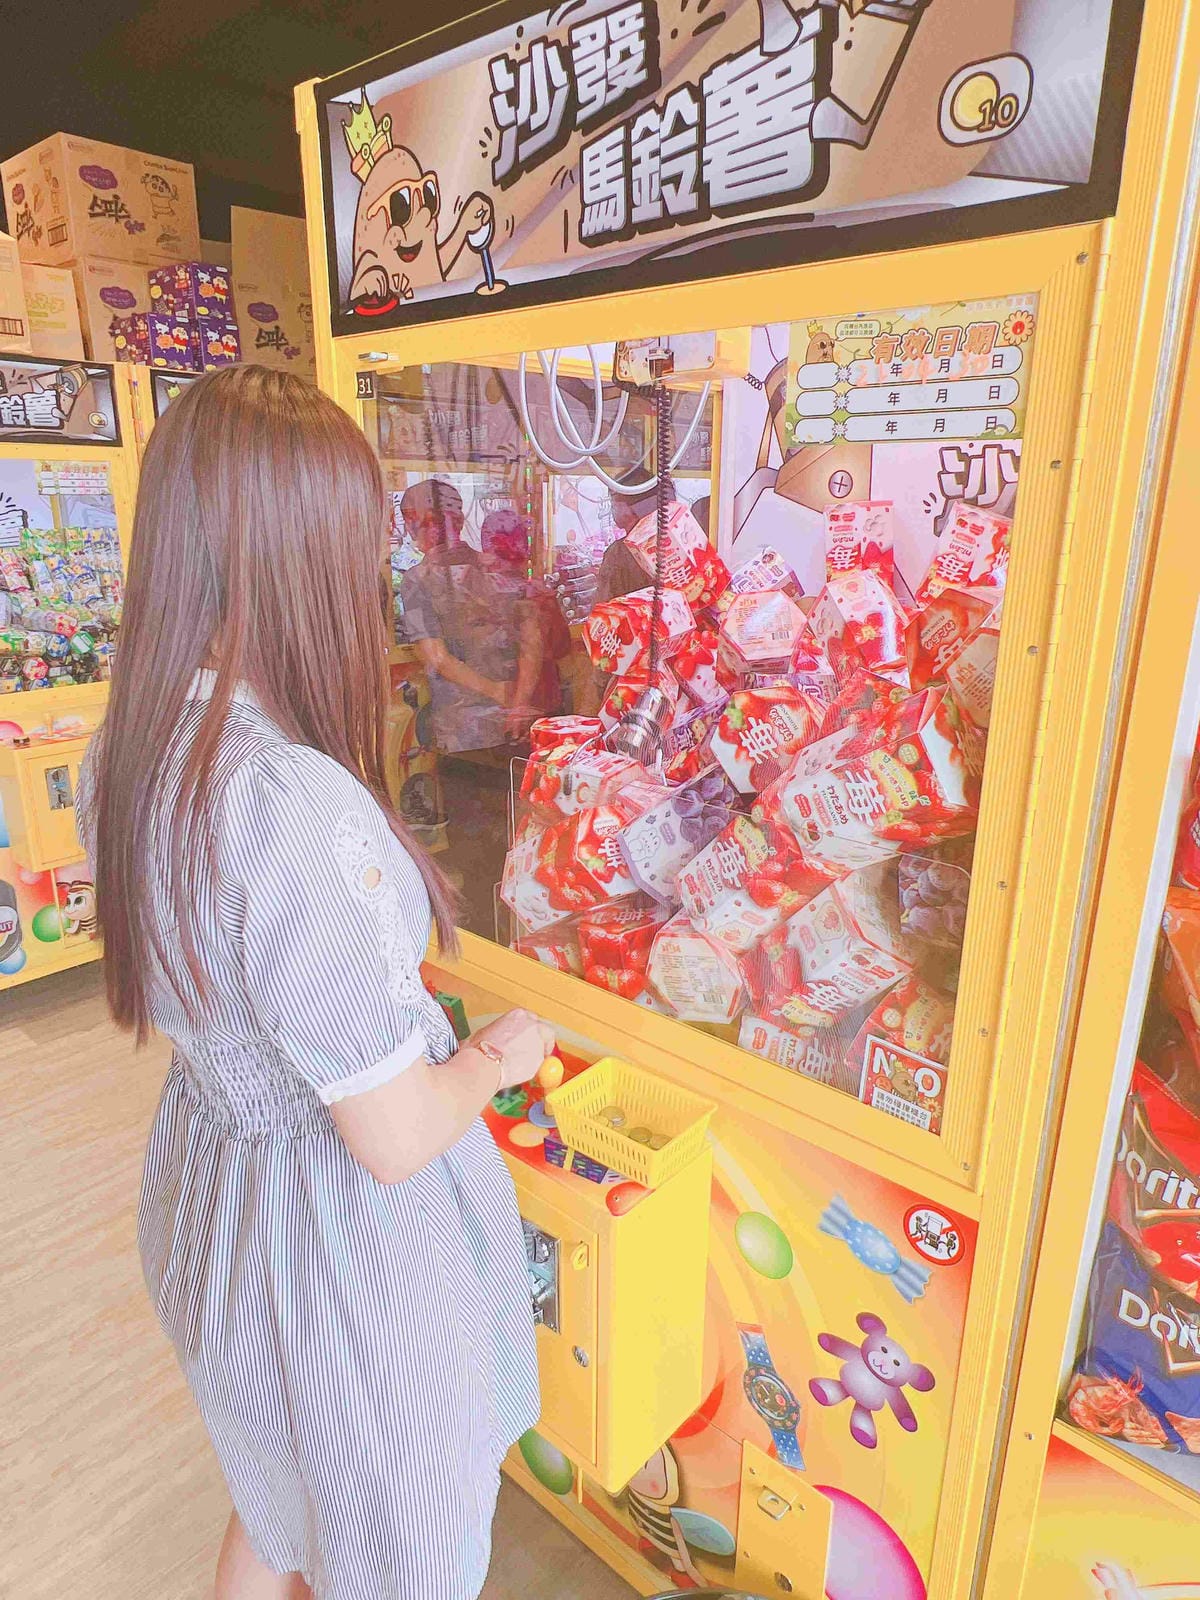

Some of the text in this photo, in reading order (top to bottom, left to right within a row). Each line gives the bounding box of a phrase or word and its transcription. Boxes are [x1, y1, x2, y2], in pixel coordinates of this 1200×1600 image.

[491, 2, 650, 183] 沙發
[581, 7, 823, 239] 馬鈴薯
[978, 92, 1019, 132] 10
[872, 323, 999, 364] 有效日期
[890, 362, 903, 377] 年
[938, 358, 951, 373] 月
[992, 354, 1004, 369] 日
[358, 378, 373, 395] 31
[887, 386, 1001, 406] 年 月 日
[885, 416, 998, 434] 年 月 日
